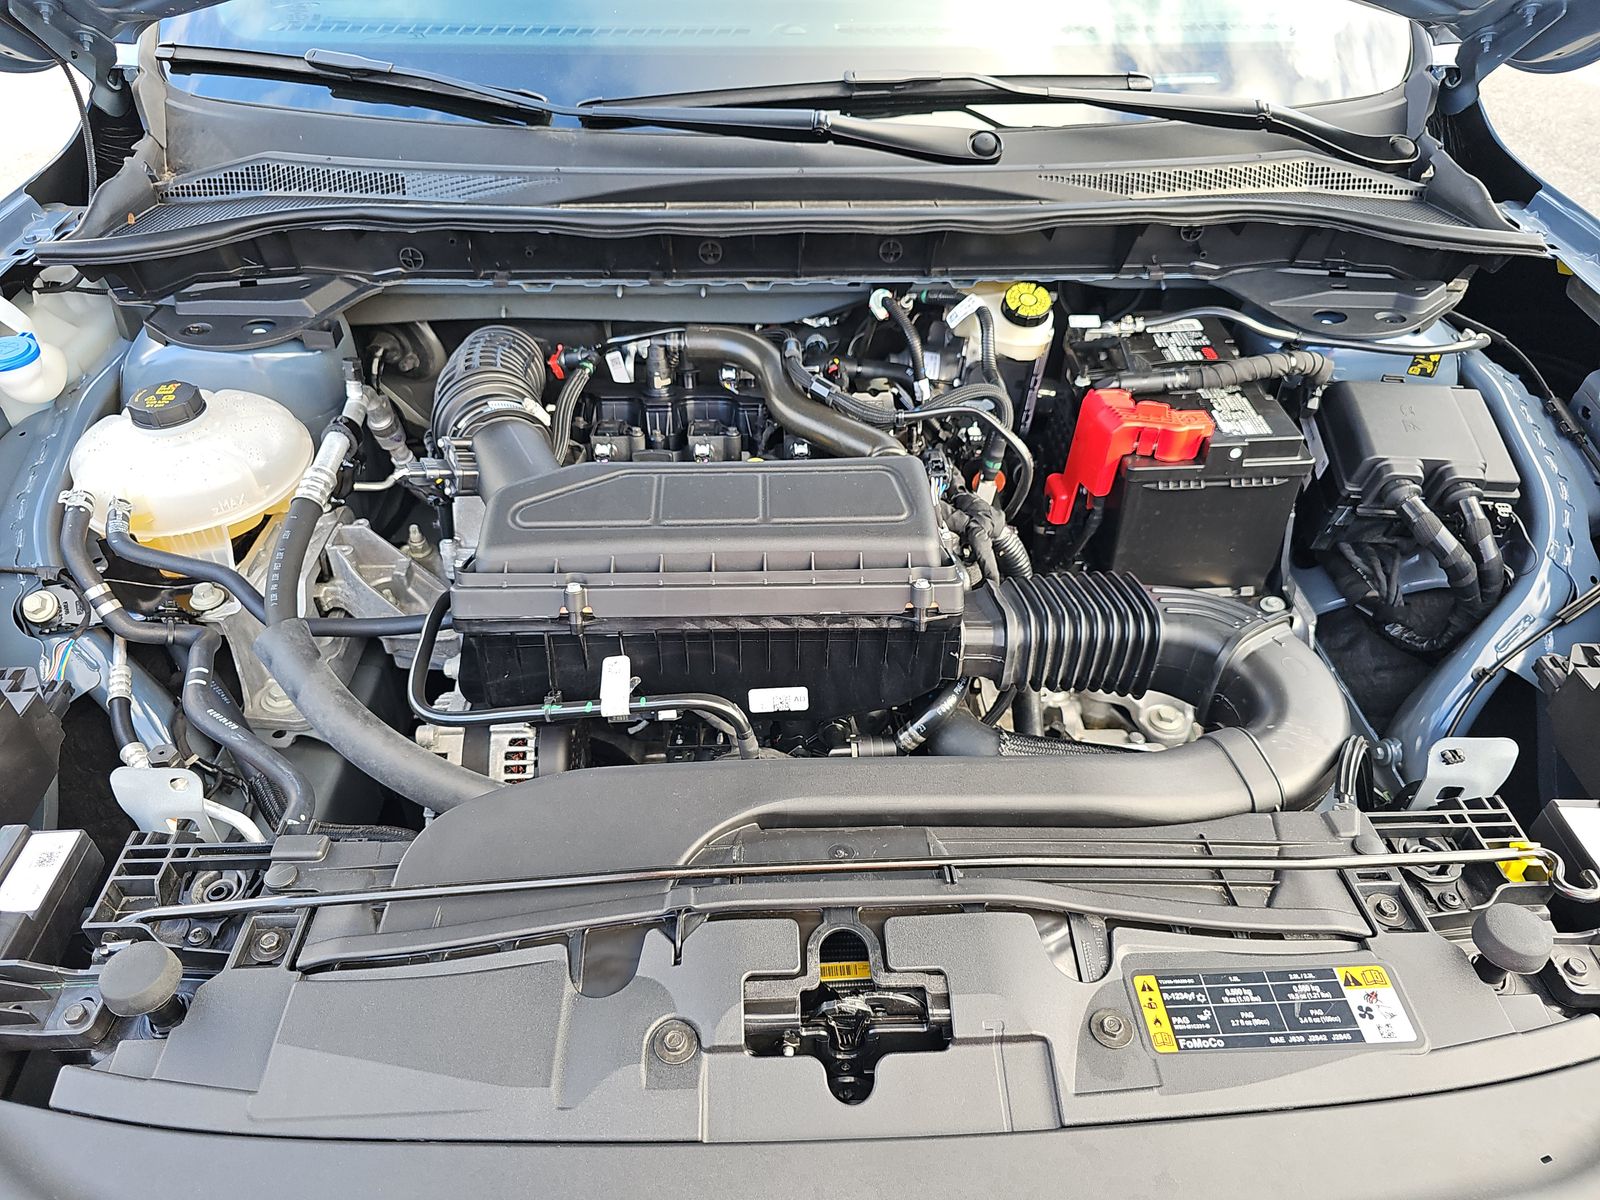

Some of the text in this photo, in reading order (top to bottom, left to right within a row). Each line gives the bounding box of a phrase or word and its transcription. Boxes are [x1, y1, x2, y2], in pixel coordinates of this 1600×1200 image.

[1240, 1011, 1255, 1019] PAG
[1309, 1008, 1324, 1016] PAG
[1171, 1016, 1190, 1025] PAG
[1179, 1038, 1225, 1050] FoMoCo
[1269, 1036, 1286, 1044] SAE
